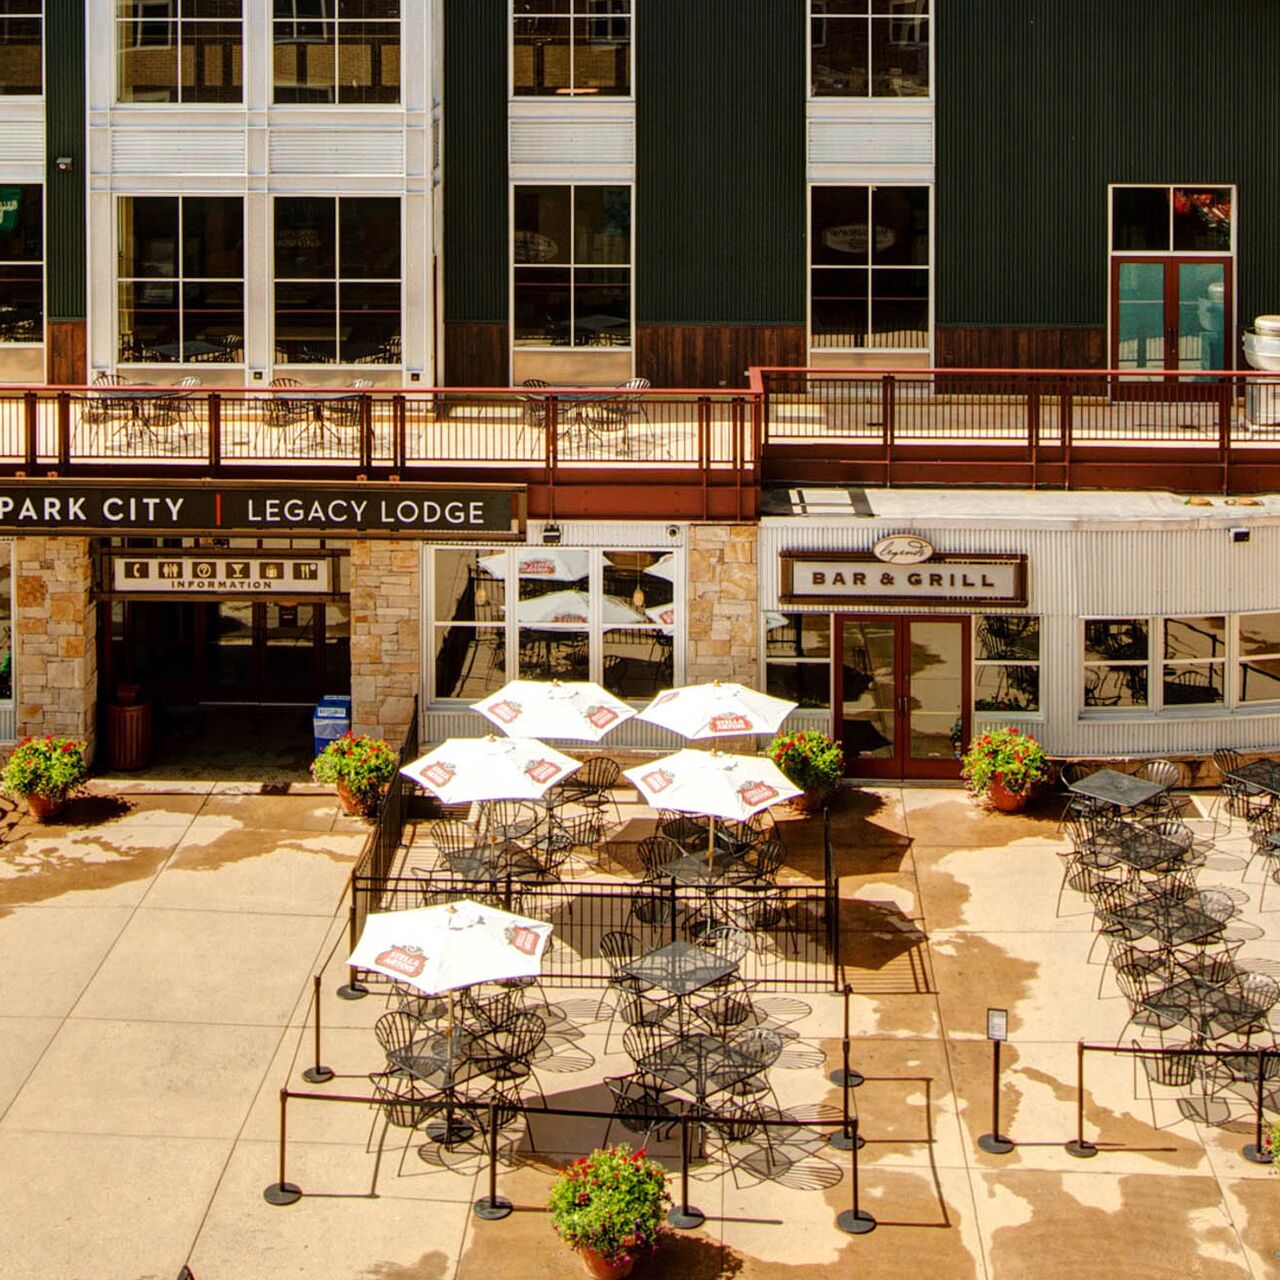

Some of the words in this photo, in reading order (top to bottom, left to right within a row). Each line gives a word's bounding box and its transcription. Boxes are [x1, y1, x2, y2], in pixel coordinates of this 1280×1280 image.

[102, 497, 185, 521] CITY
[247, 499, 368, 523] LEGACY
[380, 500, 485, 524] LODGE
[171, 580, 272, 590] INFORMATION
[812, 572, 867, 586] BAR
[879, 572, 895, 586] &
[907, 572, 995, 588] GRILL
